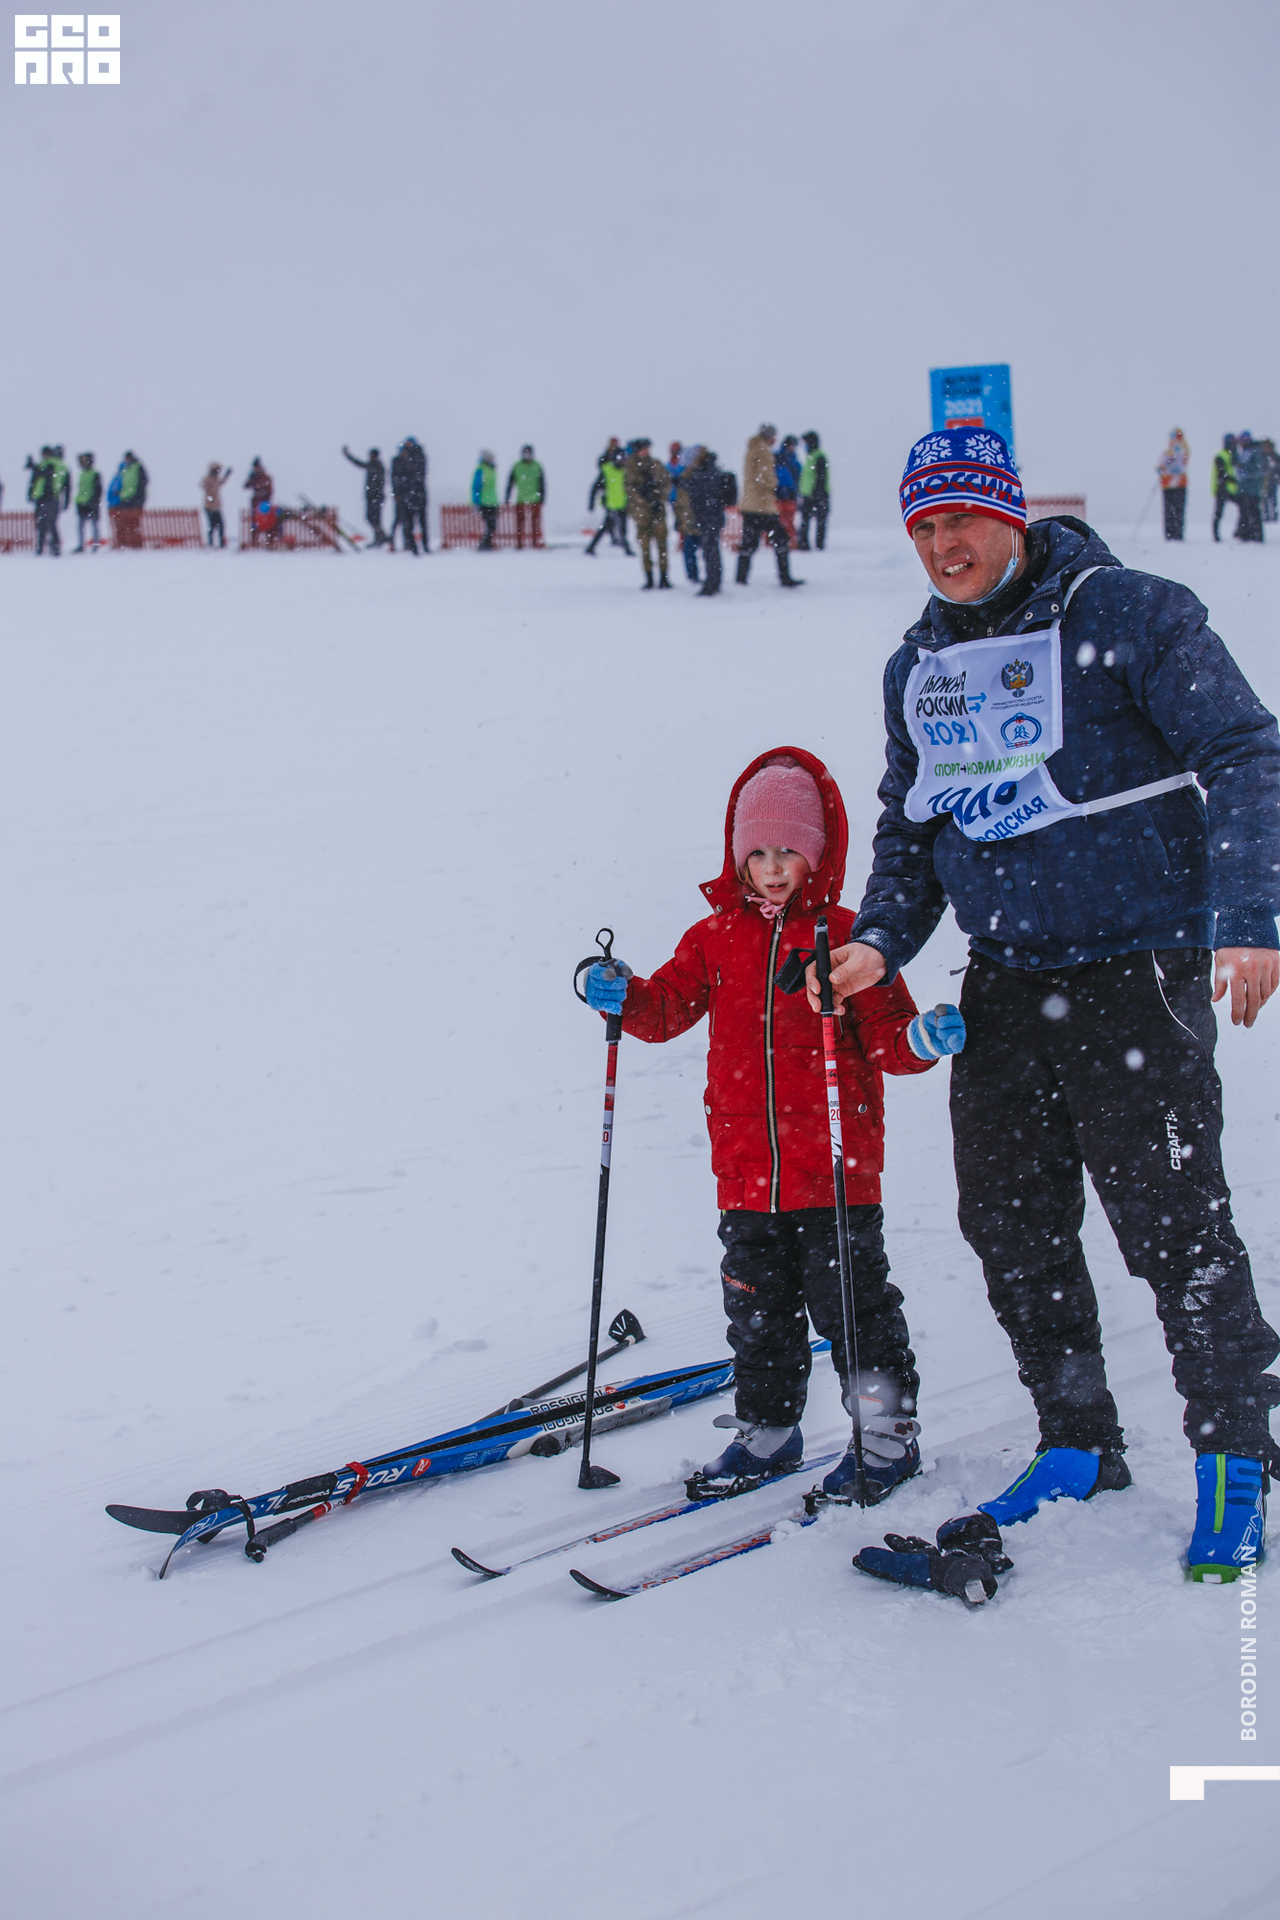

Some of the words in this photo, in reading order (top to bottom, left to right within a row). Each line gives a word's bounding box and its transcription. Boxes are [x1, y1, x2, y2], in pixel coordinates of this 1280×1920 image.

[909, 471, 1013, 504] РОССИИ
[919, 670, 966, 695] ЛЫЖНЯ
[916, 694, 969, 718] РОССИИ
[923, 719, 978, 745] 2021
[934, 762, 960, 776] СПОРТ
[1166, 1121, 1182, 1171] CRAFT
